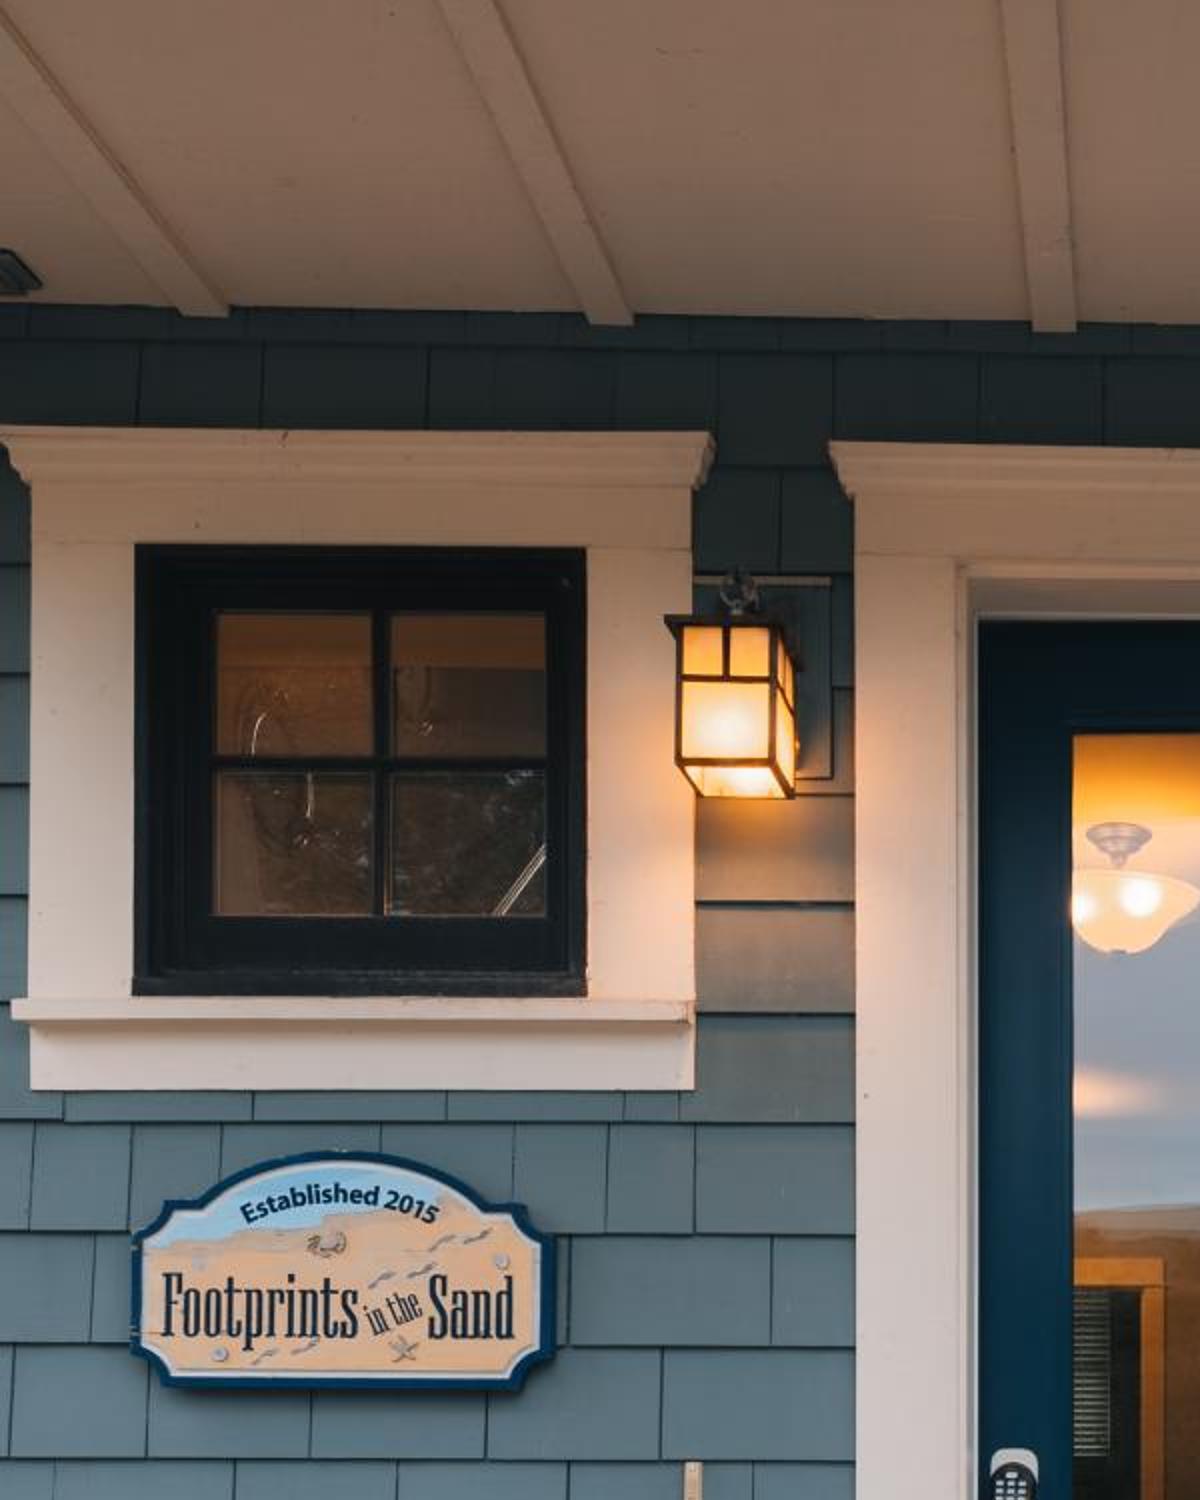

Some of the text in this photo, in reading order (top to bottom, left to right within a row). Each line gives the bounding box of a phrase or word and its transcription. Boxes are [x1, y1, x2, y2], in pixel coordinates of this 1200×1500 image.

[240, 1182, 440, 1225] Established 2015
[161, 1272, 515, 1352] Footprints in the Sand
